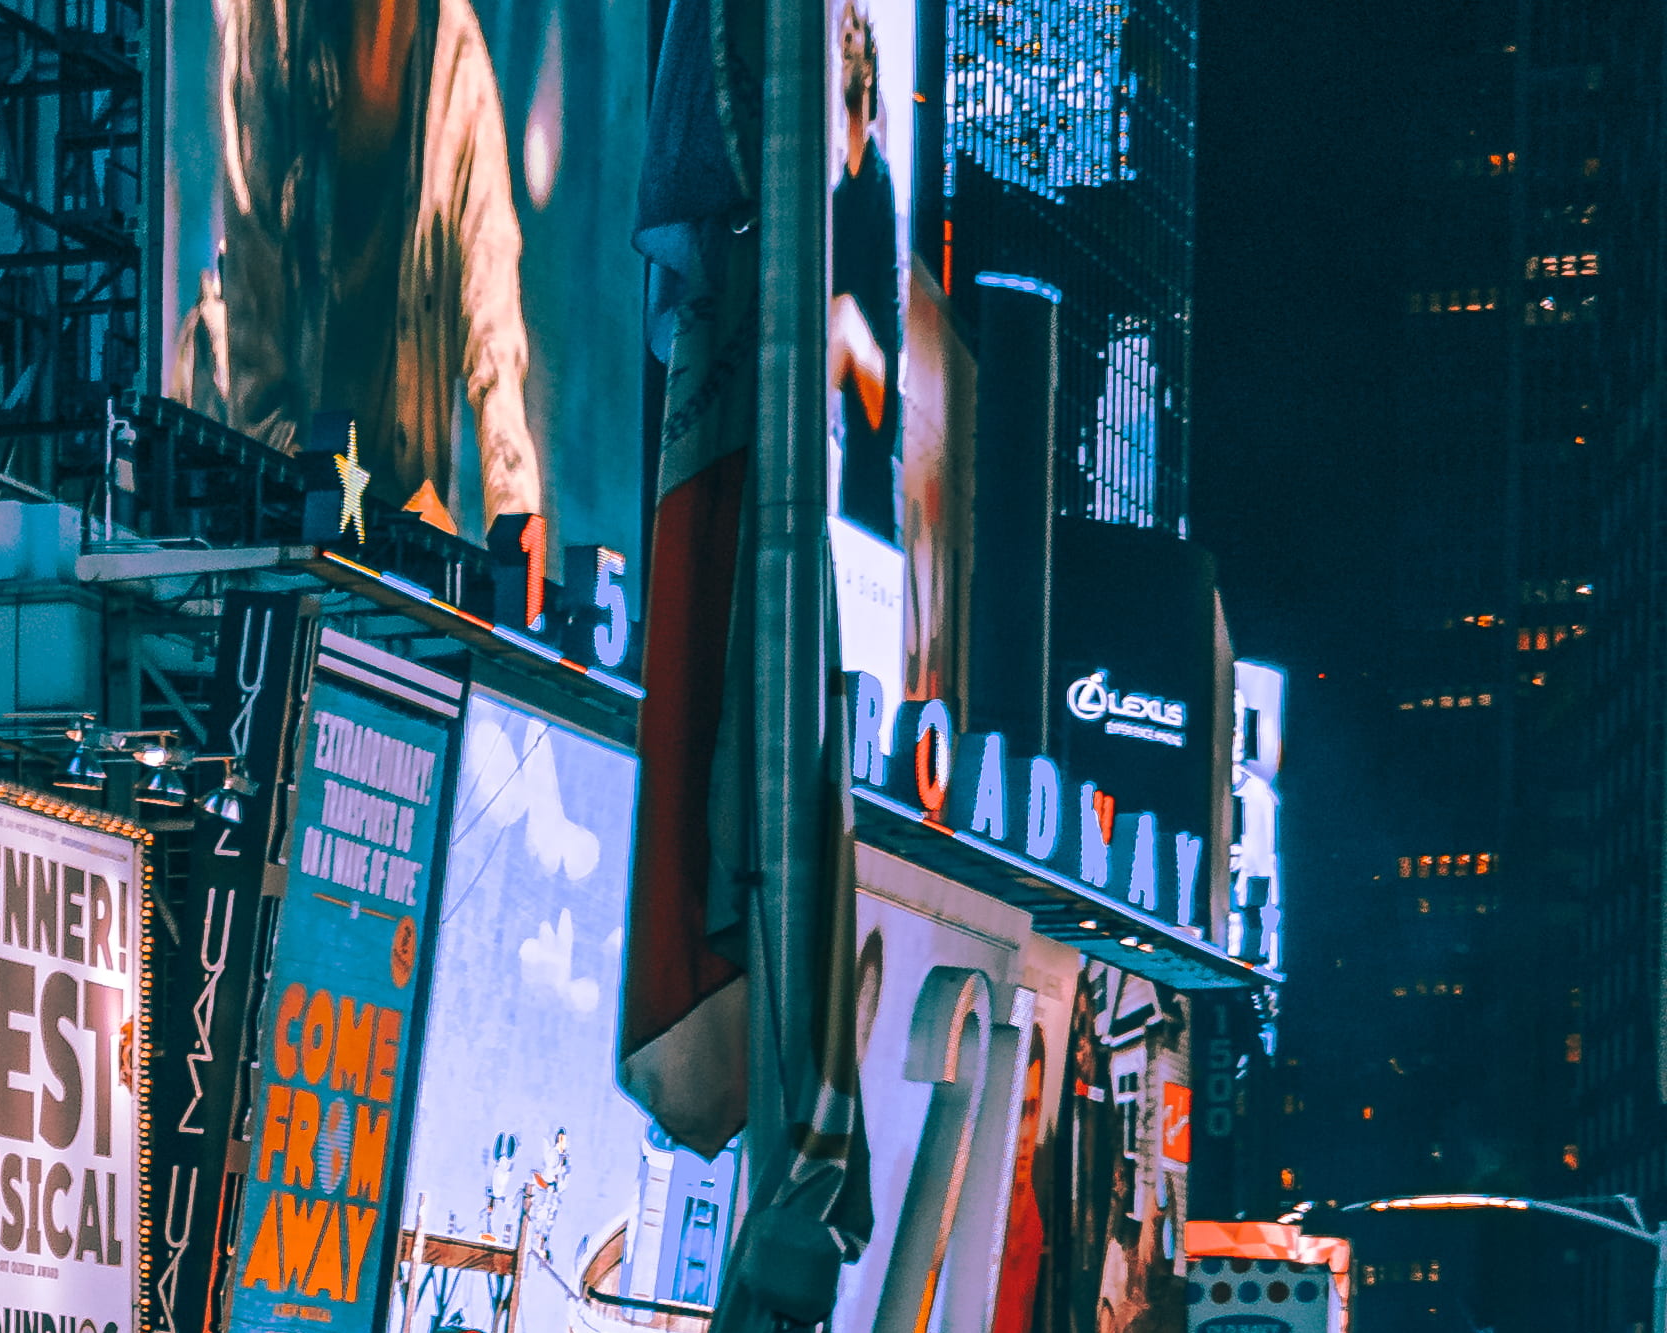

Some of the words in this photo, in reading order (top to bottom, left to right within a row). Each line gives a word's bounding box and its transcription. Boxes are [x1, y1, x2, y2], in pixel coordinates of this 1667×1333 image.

[1107, 691, 1184, 727] LEXUS
[274, 982, 402, 1103] COME
[241, 1190, 377, 1303] AWAY
